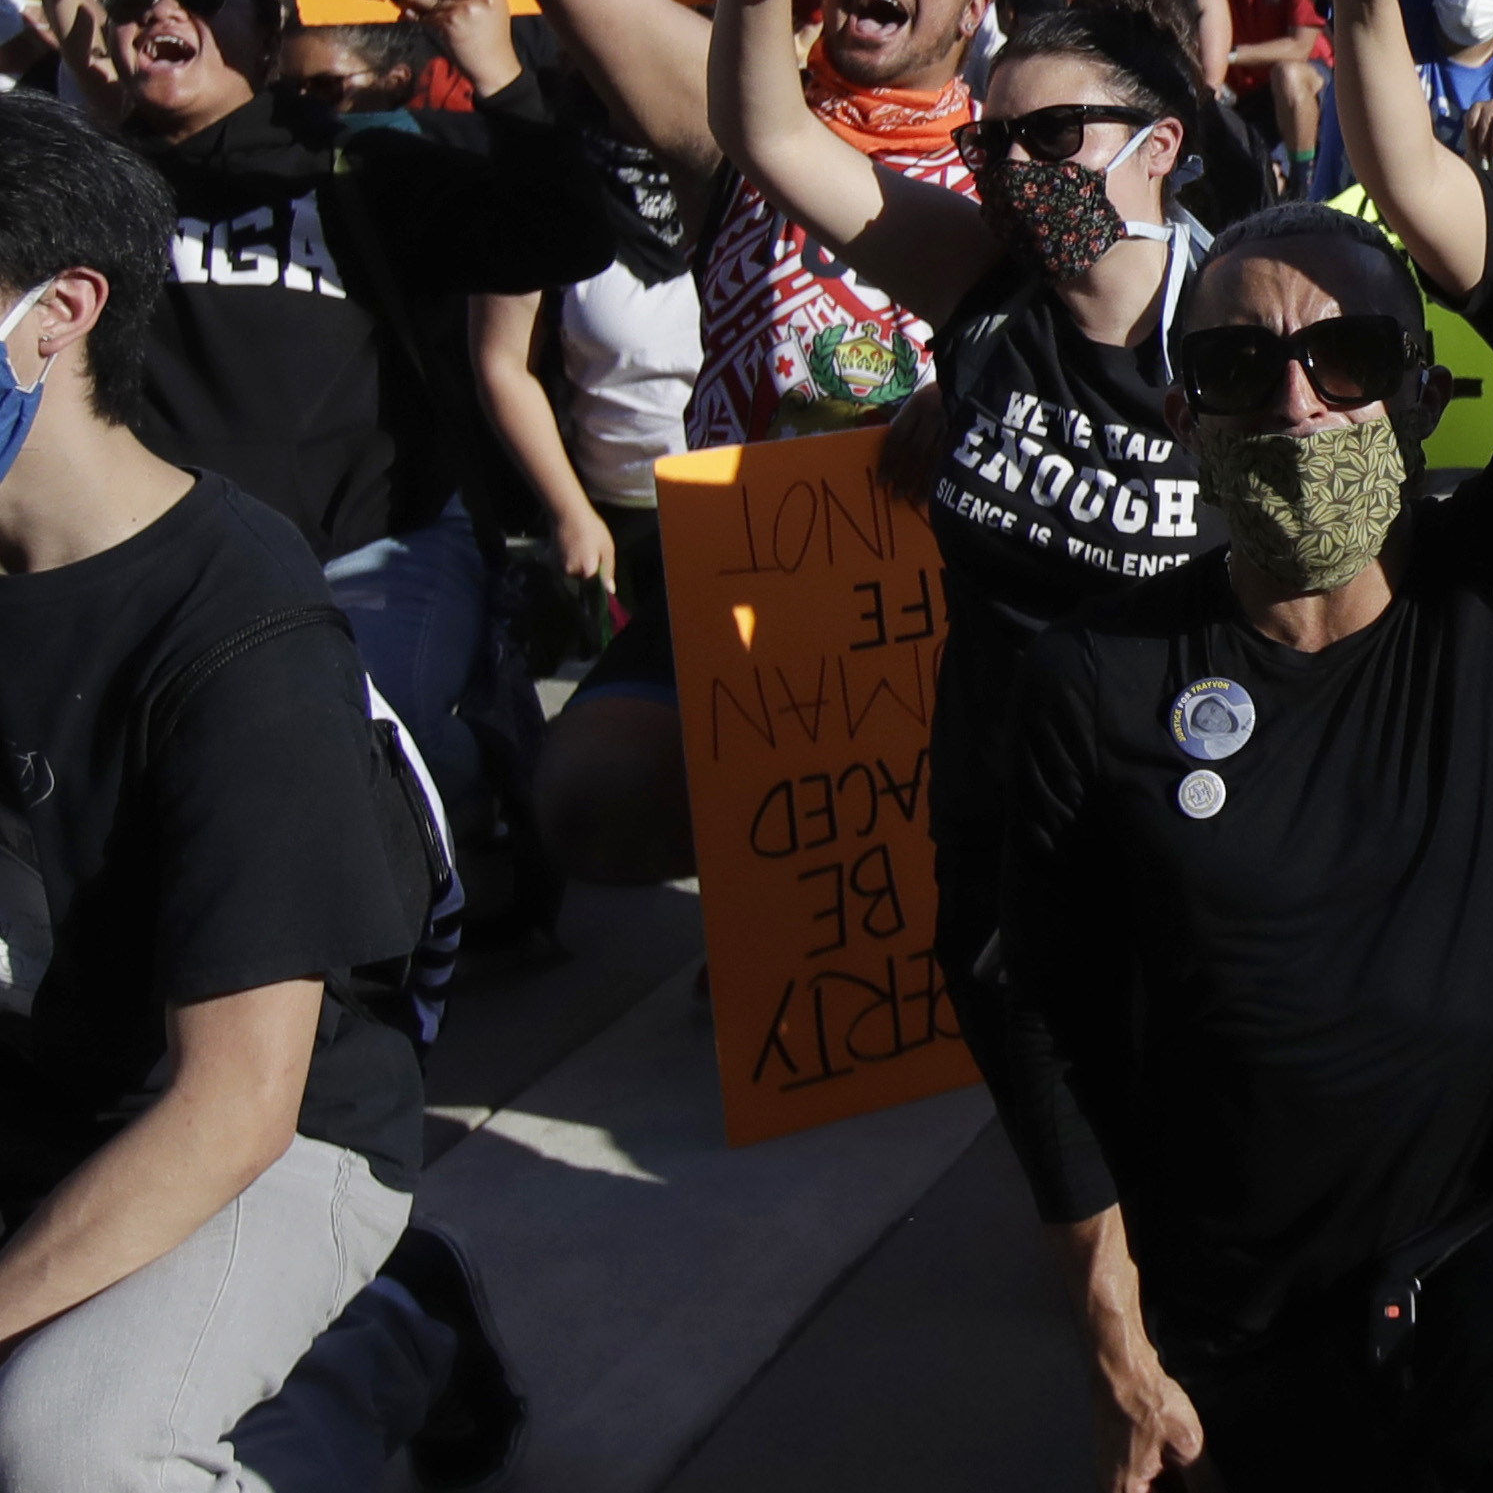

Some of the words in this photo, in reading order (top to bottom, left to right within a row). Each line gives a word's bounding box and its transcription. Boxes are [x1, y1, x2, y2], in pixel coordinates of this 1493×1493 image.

[935, 477, 1018, 534] SILENCE
[1029, 522, 1053, 549] IS
[952, 412, 1200, 538] ENOUGH
[712, 643, 947, 762] MAN
[796, 843, 906, 960] BE
